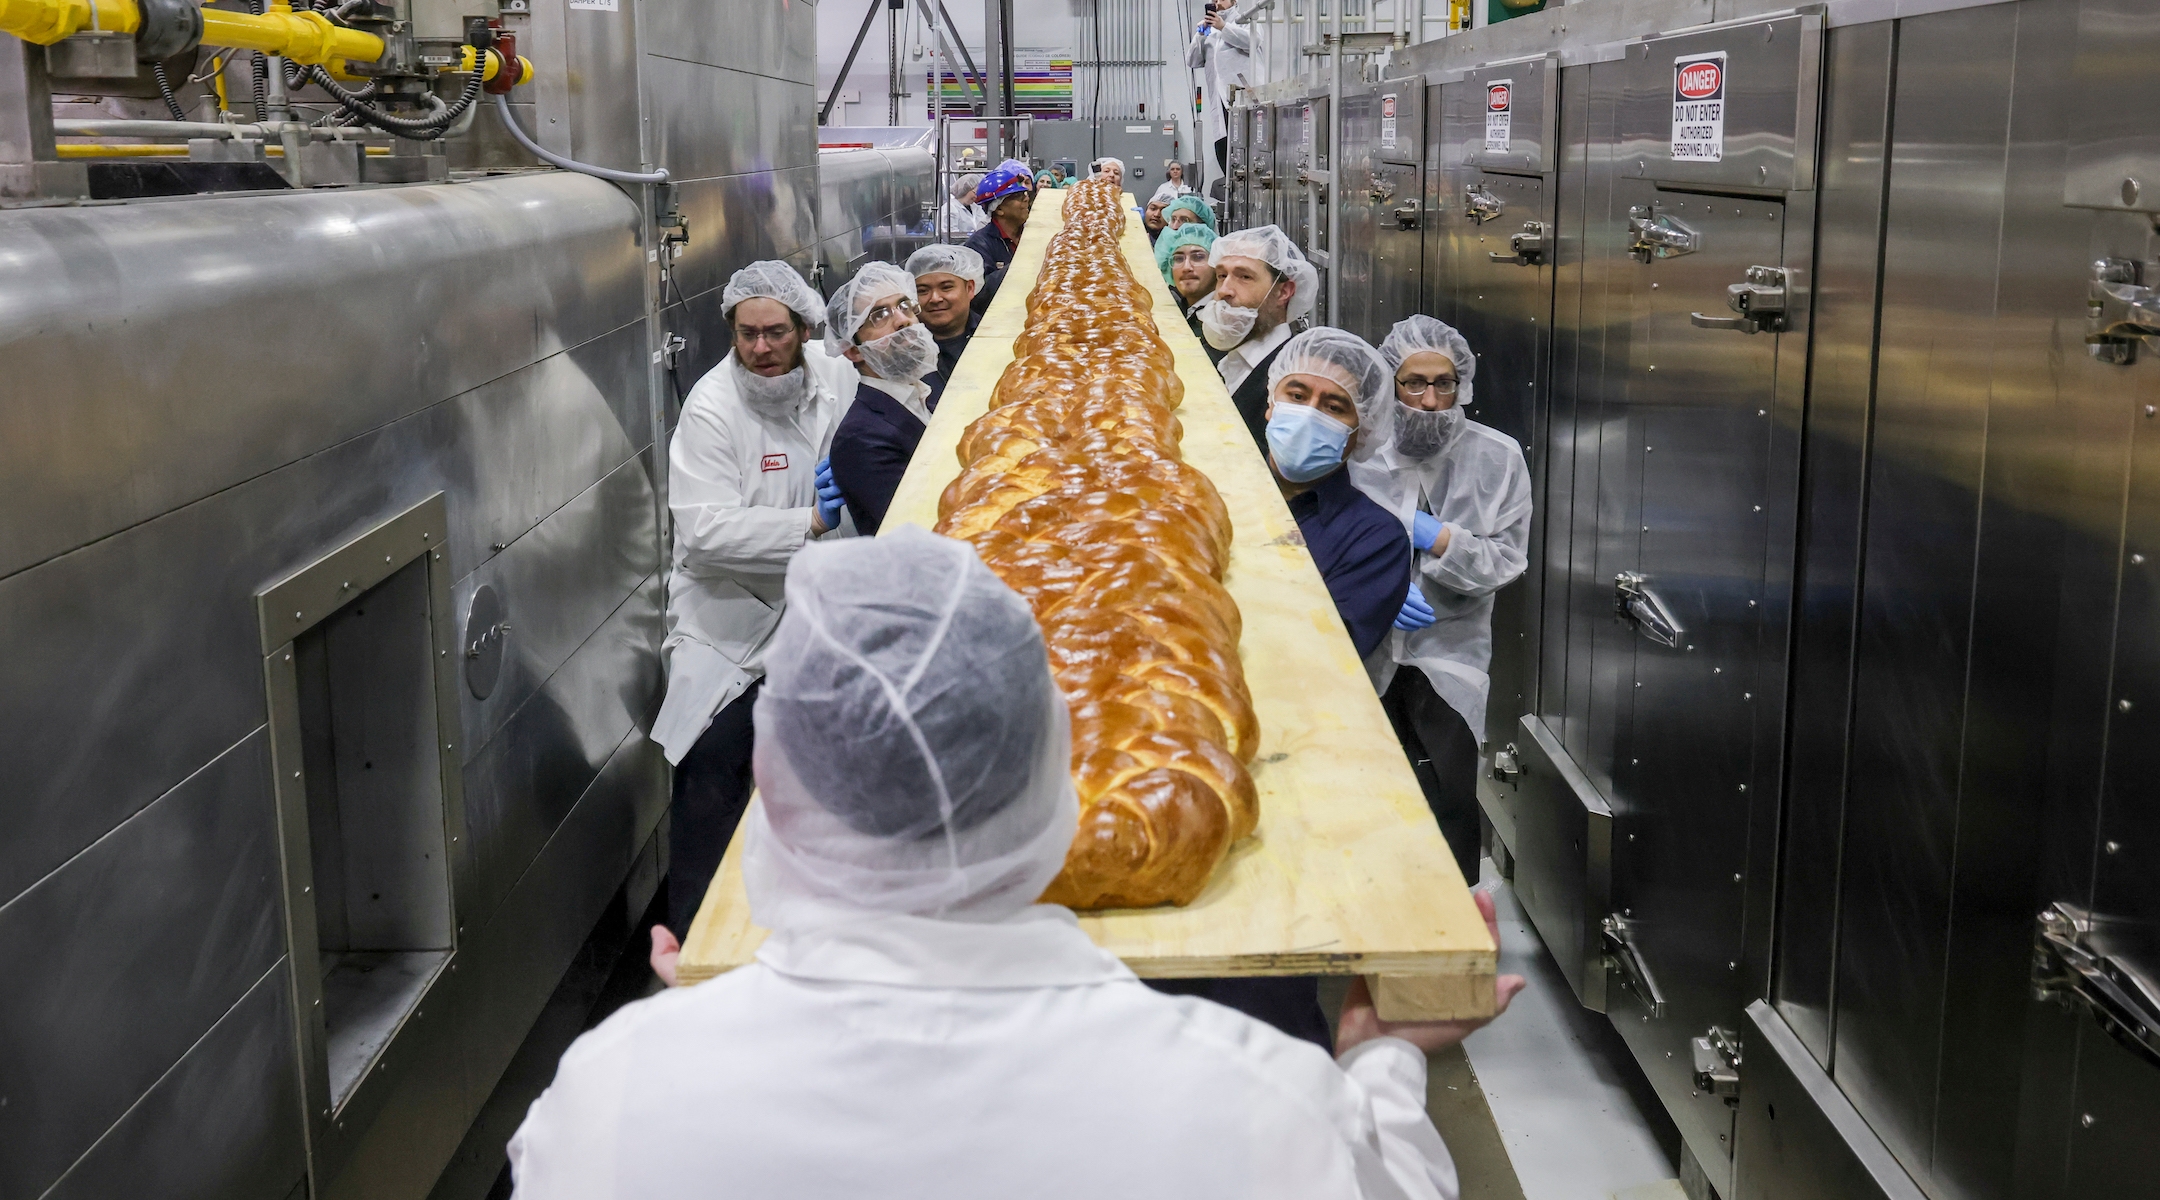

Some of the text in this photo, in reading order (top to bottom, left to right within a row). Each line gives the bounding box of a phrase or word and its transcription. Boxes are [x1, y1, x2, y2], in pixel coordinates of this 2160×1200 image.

[1682, 69, 1716, 91] DANGER
[1491, 91, 1507, 105] DANGER
[1675, 103, 1720, 122] DO NOT ENTER
[1680, 126, 1713, 139] AUTHORIZED
[1674, 143, 1703, 156] PERSONNEL
